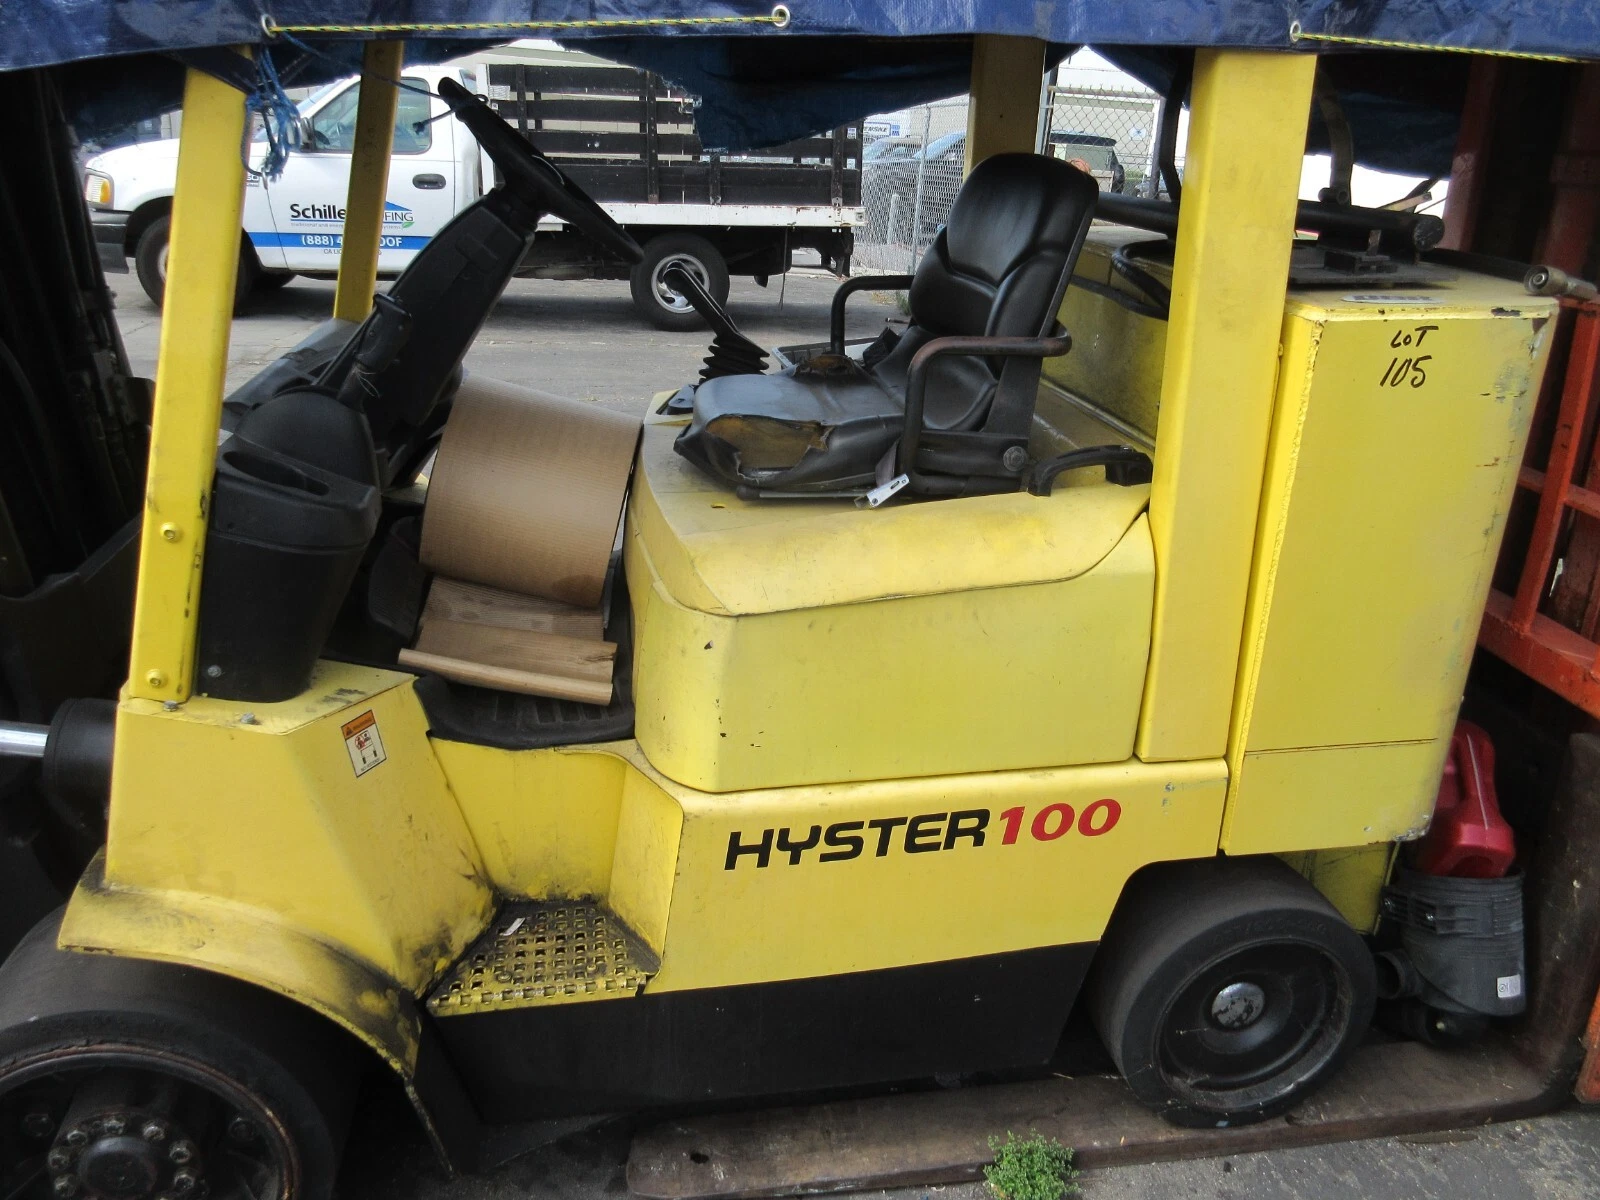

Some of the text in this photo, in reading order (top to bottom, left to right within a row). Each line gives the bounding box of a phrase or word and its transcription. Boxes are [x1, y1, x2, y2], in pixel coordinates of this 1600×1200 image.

[290, 203, 414, 222] Schille FING
[301, 235, 334, 247] (888)
[1390, 325, 1440, 348] LOT
[1379, 354, 1433, 388] 105
[724, 798, 1122, 870] HYSTER 100
